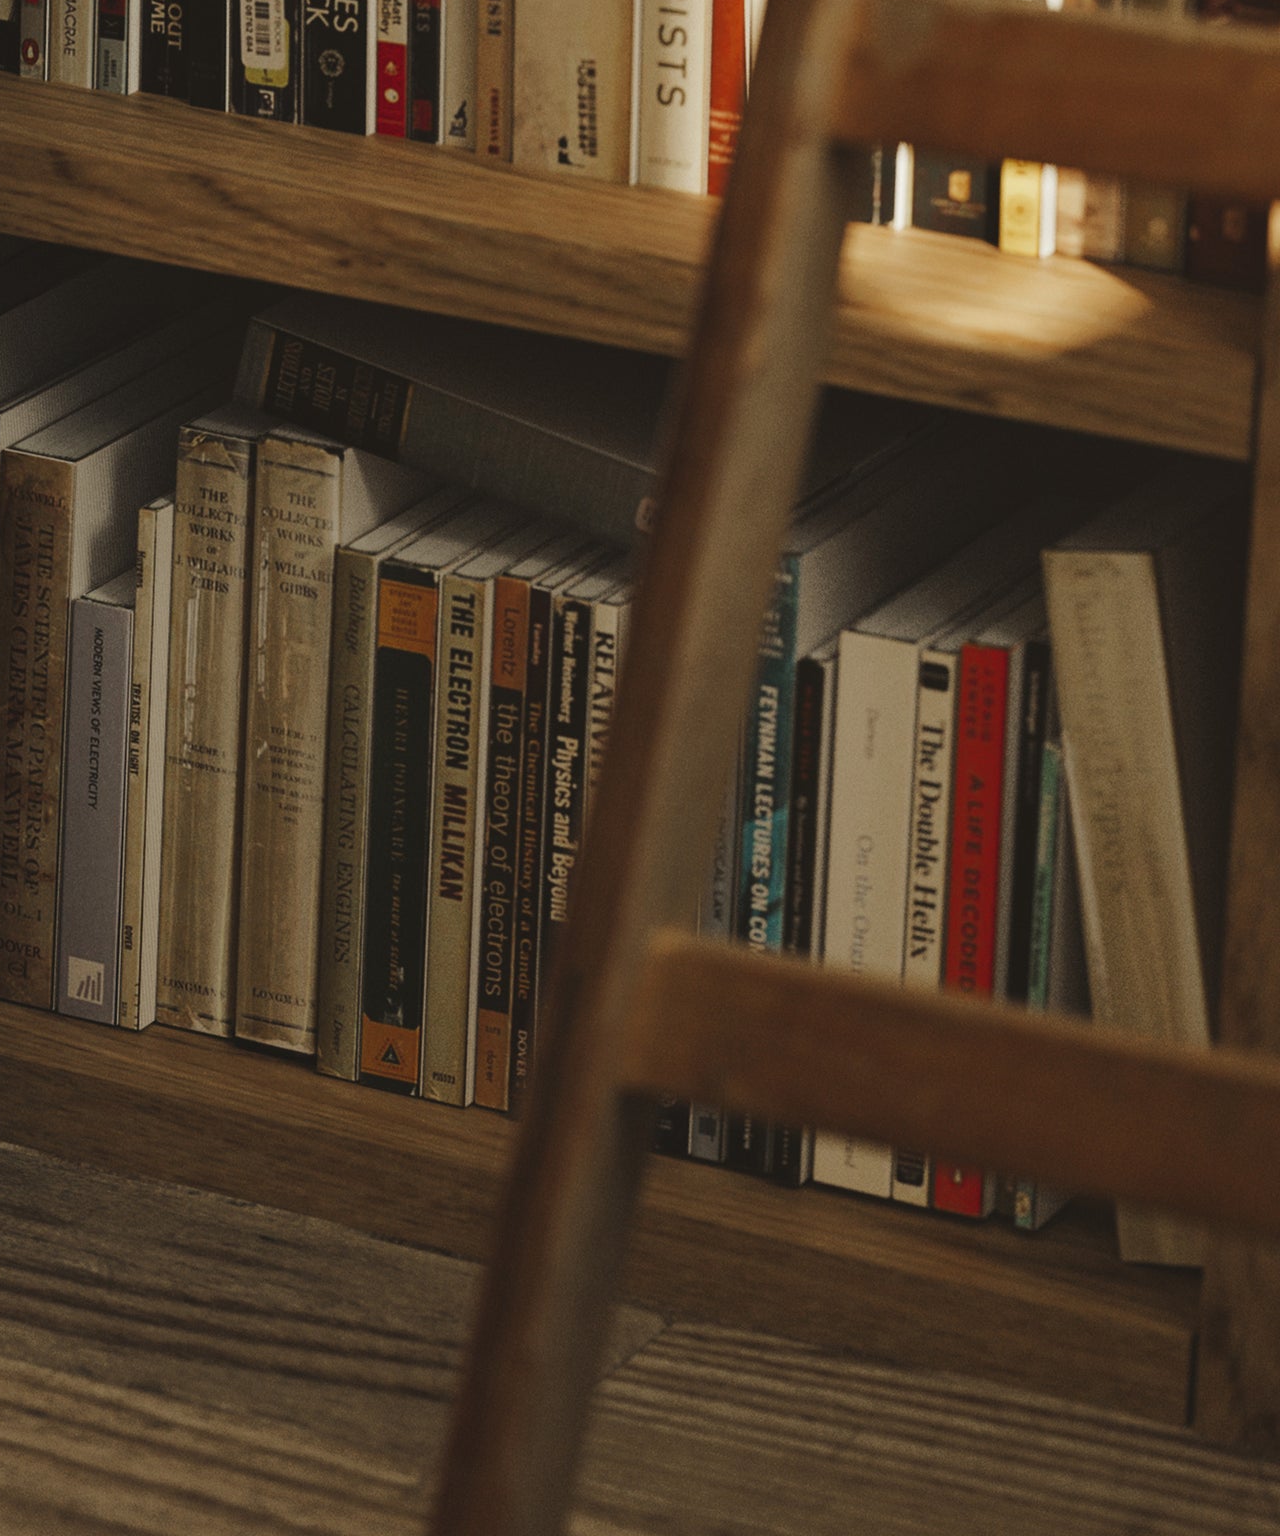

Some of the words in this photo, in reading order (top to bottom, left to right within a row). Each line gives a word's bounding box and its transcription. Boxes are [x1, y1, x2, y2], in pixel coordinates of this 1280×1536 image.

[166, 2, 183, 51] OUT
[199, 486, 229, 505] THE
[286, 491, 317, 510] THE
[36, 525, 56, 580] THE
[188, 522, 236, 543] WORKS
[275, 526, 324, 548] WORKS
[11, 523, 33, 618] JAMES
[278, 581, 319, 601] GIBBS
[342, 571, 367, 657] Babbage
[450, 593, 476, 639] THE
[501, 606, 522, 677] Lorentz
[561, 610, 582, 656] Werner
[7, 625, 31, 727] CLERK
[29, 586, 53, 733] SCIENTIFIC
[91, 625, 104, 677] MODERN
[90, 680, 102, 715] VIEWS
[130, 683, 142, 725] TREATISE
[444, 646, 474, 771] ELECTRON
[528, 701, 542, 730] The
[556, 657, 578, 724] Heisenberg
[89, 717, 102, 734] OF
[130, 730, 141, 744] ON
[496, 702, 519, 745] the
[755, 683, 779, 777] FEYNMAN
[919, 723, 947, 772] The
[87, 735, 101, 810] ELECTRICITY
[128, 747, 141, 777] LIGHT
[337, 683, 362, 850] CALCULATING
[524, 737, 541, 825] Chemical
[550, 734, 580, 805] Physics
[966, 773, 986, 793] A
[0, 736, 25, 889] MAXWELL
[22, 746, 46, 850] PAPERS
[489, 755, 517, 837] theory
[439, 783, 469, 902] MILLIKAN
[551, 811, 574, 847] and
[748, 783, 775, 877] LECTURES
[913, 778, 944, 877] Double
[964, 800, 986, 856] LIFE
[490, 845, 513, 873] of
[520, 829, 539, 891] History
[545, 852, 573, 922] Beyond
[333, 861, 354, 965] ENGINES
[519, 896, 536, 914] of
[748, 882, 766, 911] ON
[908, 883, 940, 962] Helix
[483, 879, 510, 997] electrons
[519, 922, 531, 932] a
[956, 867, 984, 993] DECODED
[514, 938, 534, 1001] Candle
[516, 1027, 531, 1078] DOVER
